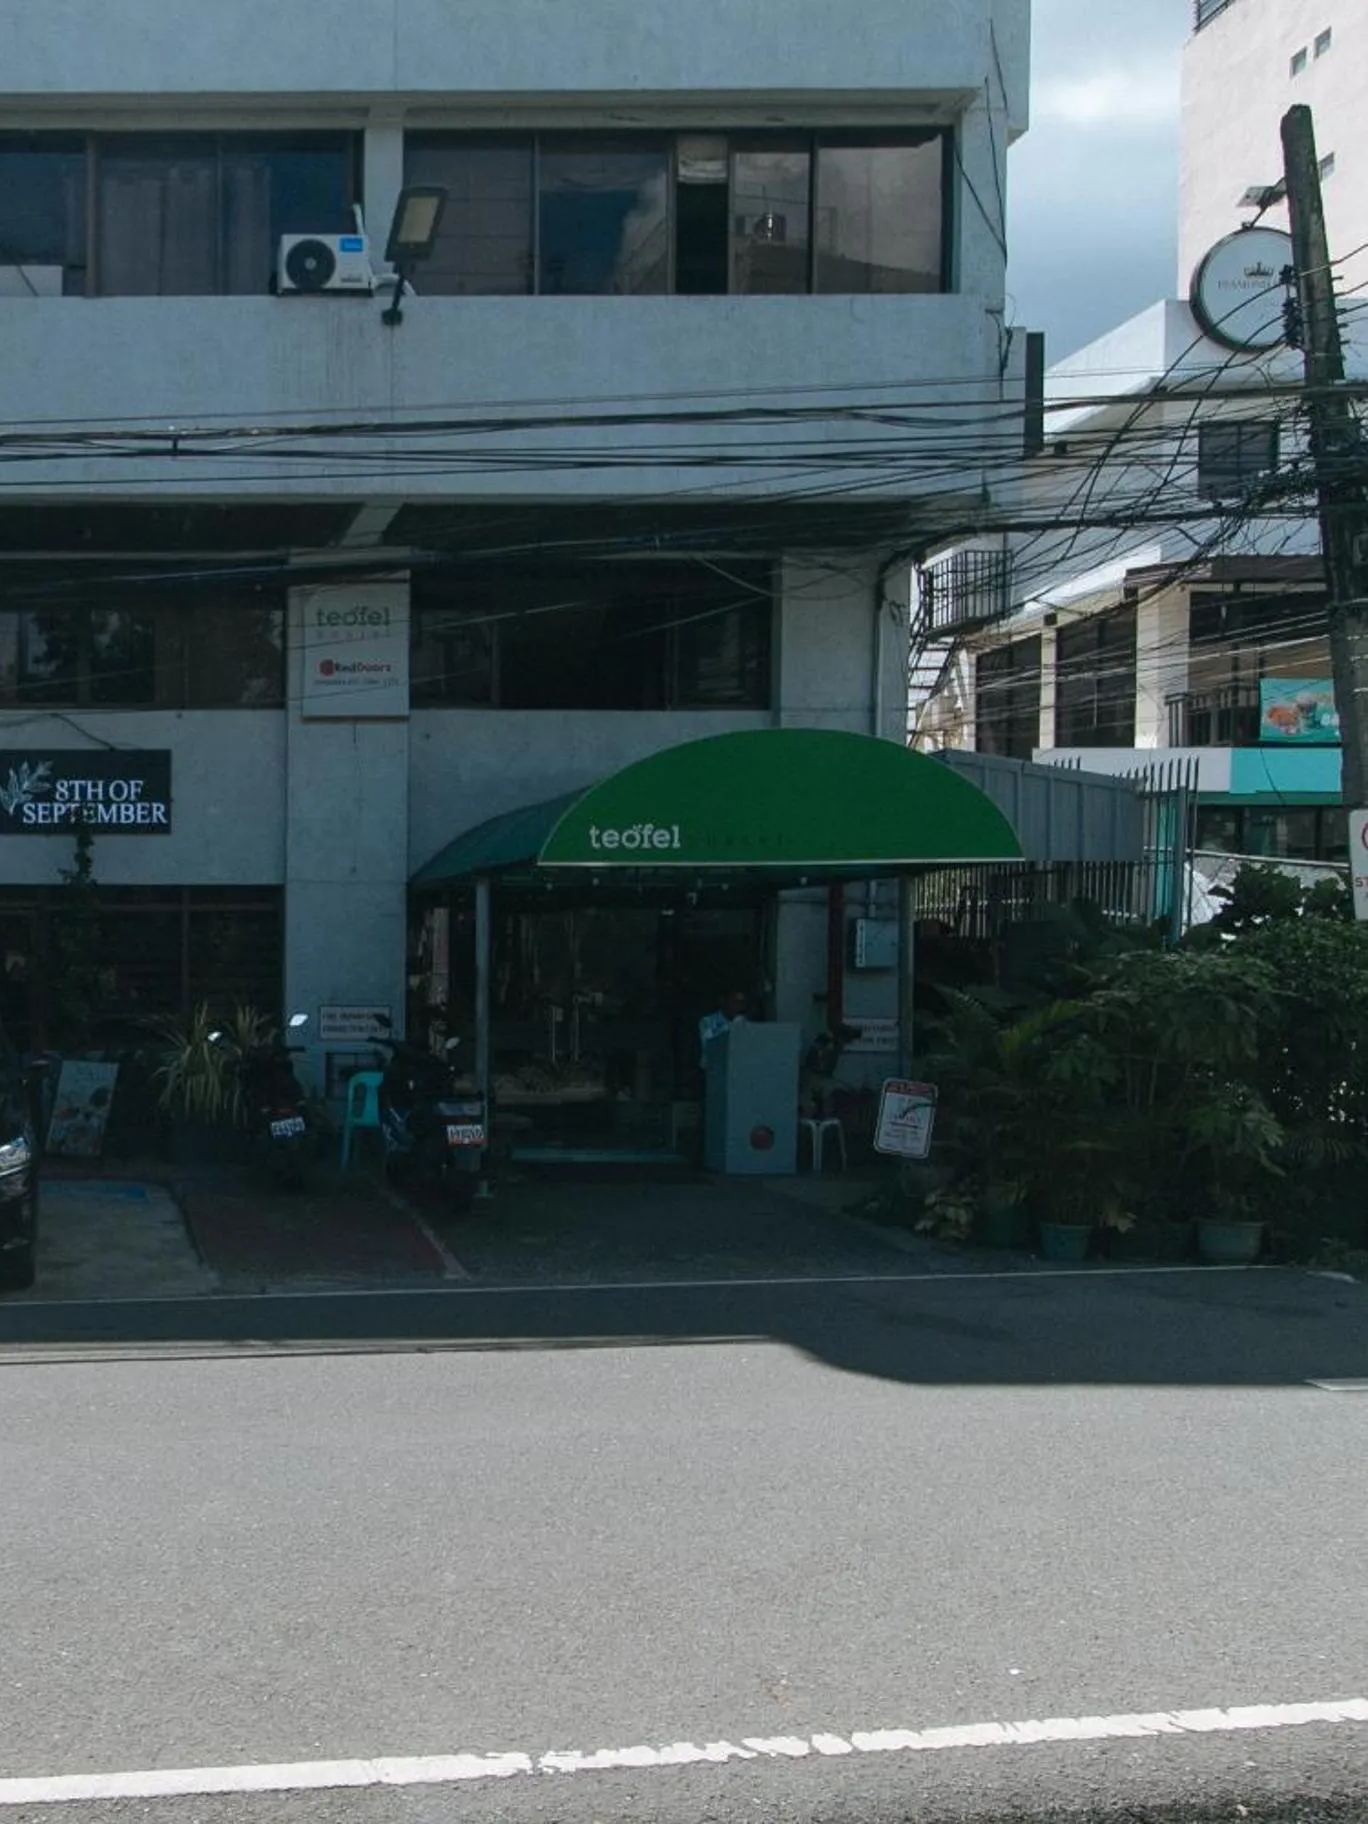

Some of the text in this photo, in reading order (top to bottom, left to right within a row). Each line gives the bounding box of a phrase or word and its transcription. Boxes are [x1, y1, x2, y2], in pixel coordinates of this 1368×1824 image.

[55, 779, 144, 801] 8TH OF
[23, 802, 168, 824] SEPTEMBER
